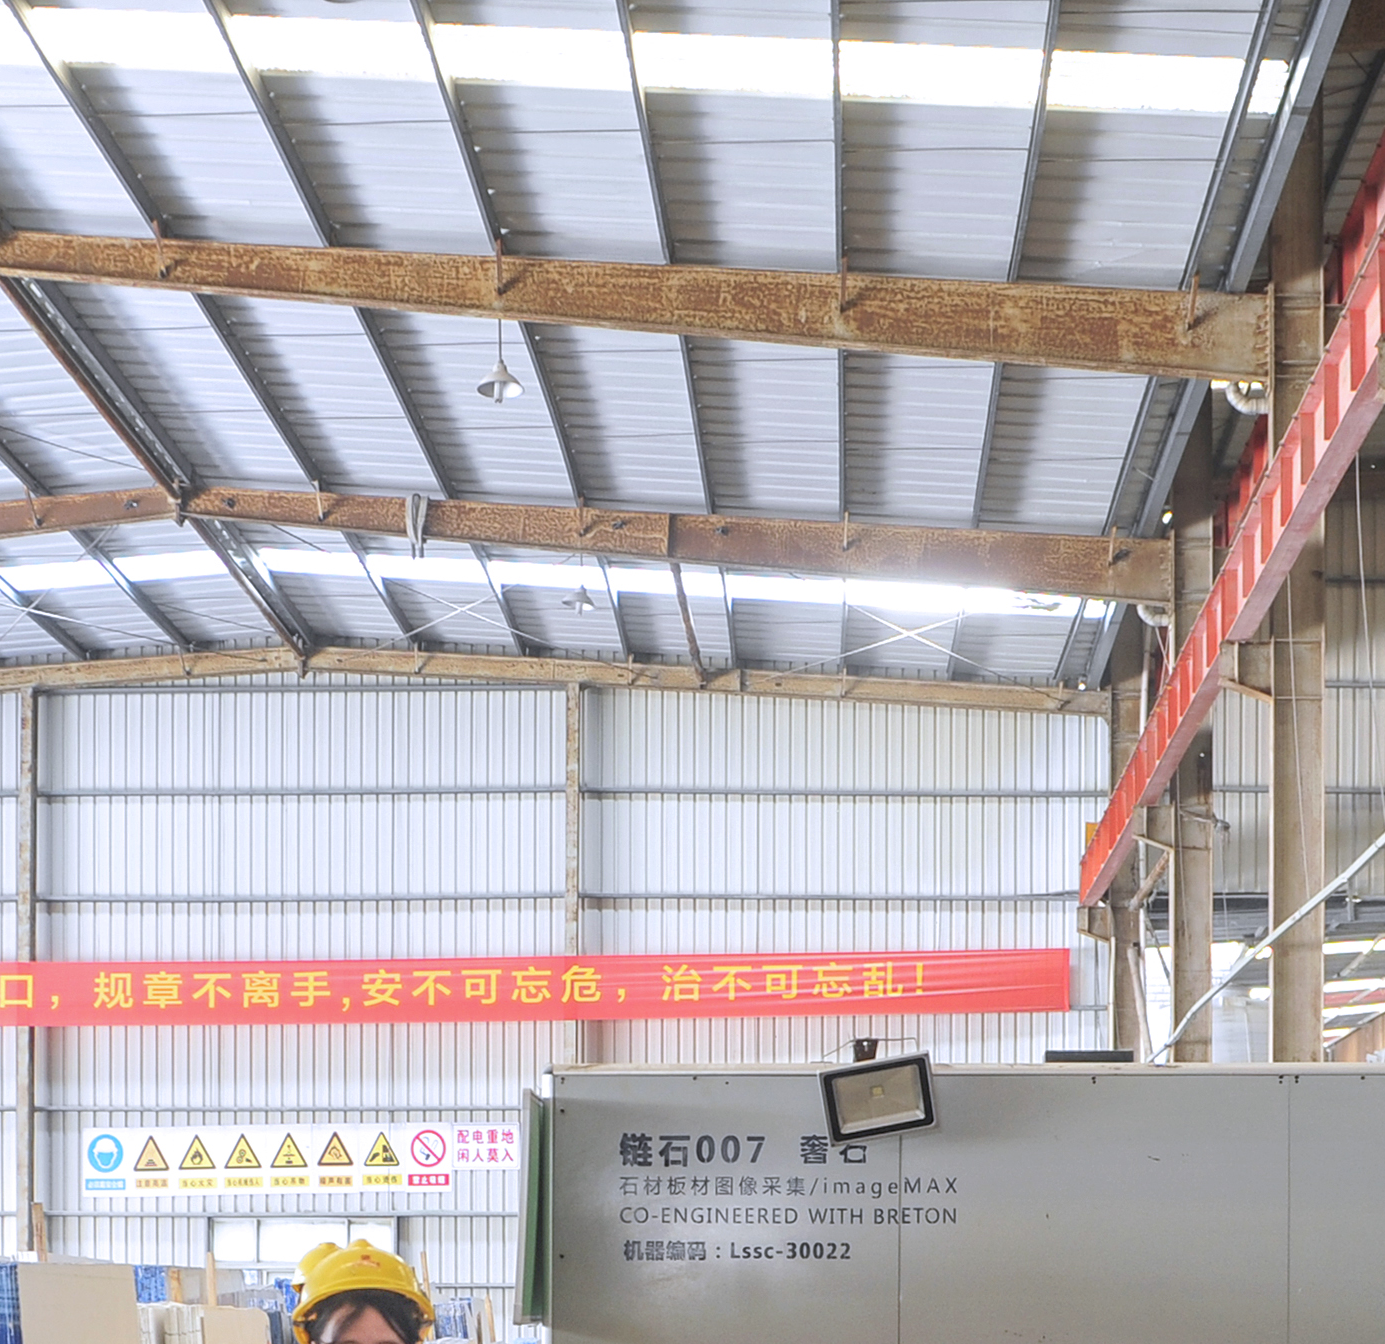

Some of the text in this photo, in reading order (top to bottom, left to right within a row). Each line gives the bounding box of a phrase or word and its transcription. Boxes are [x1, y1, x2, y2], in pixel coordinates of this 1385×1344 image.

[457, 1128, 514, 1144] 配电重地
[457, 1148, 514, 1163] 闲人莫入
[619, 1206, 957, 1225] CO-ENGINEERED WITH BRETON
